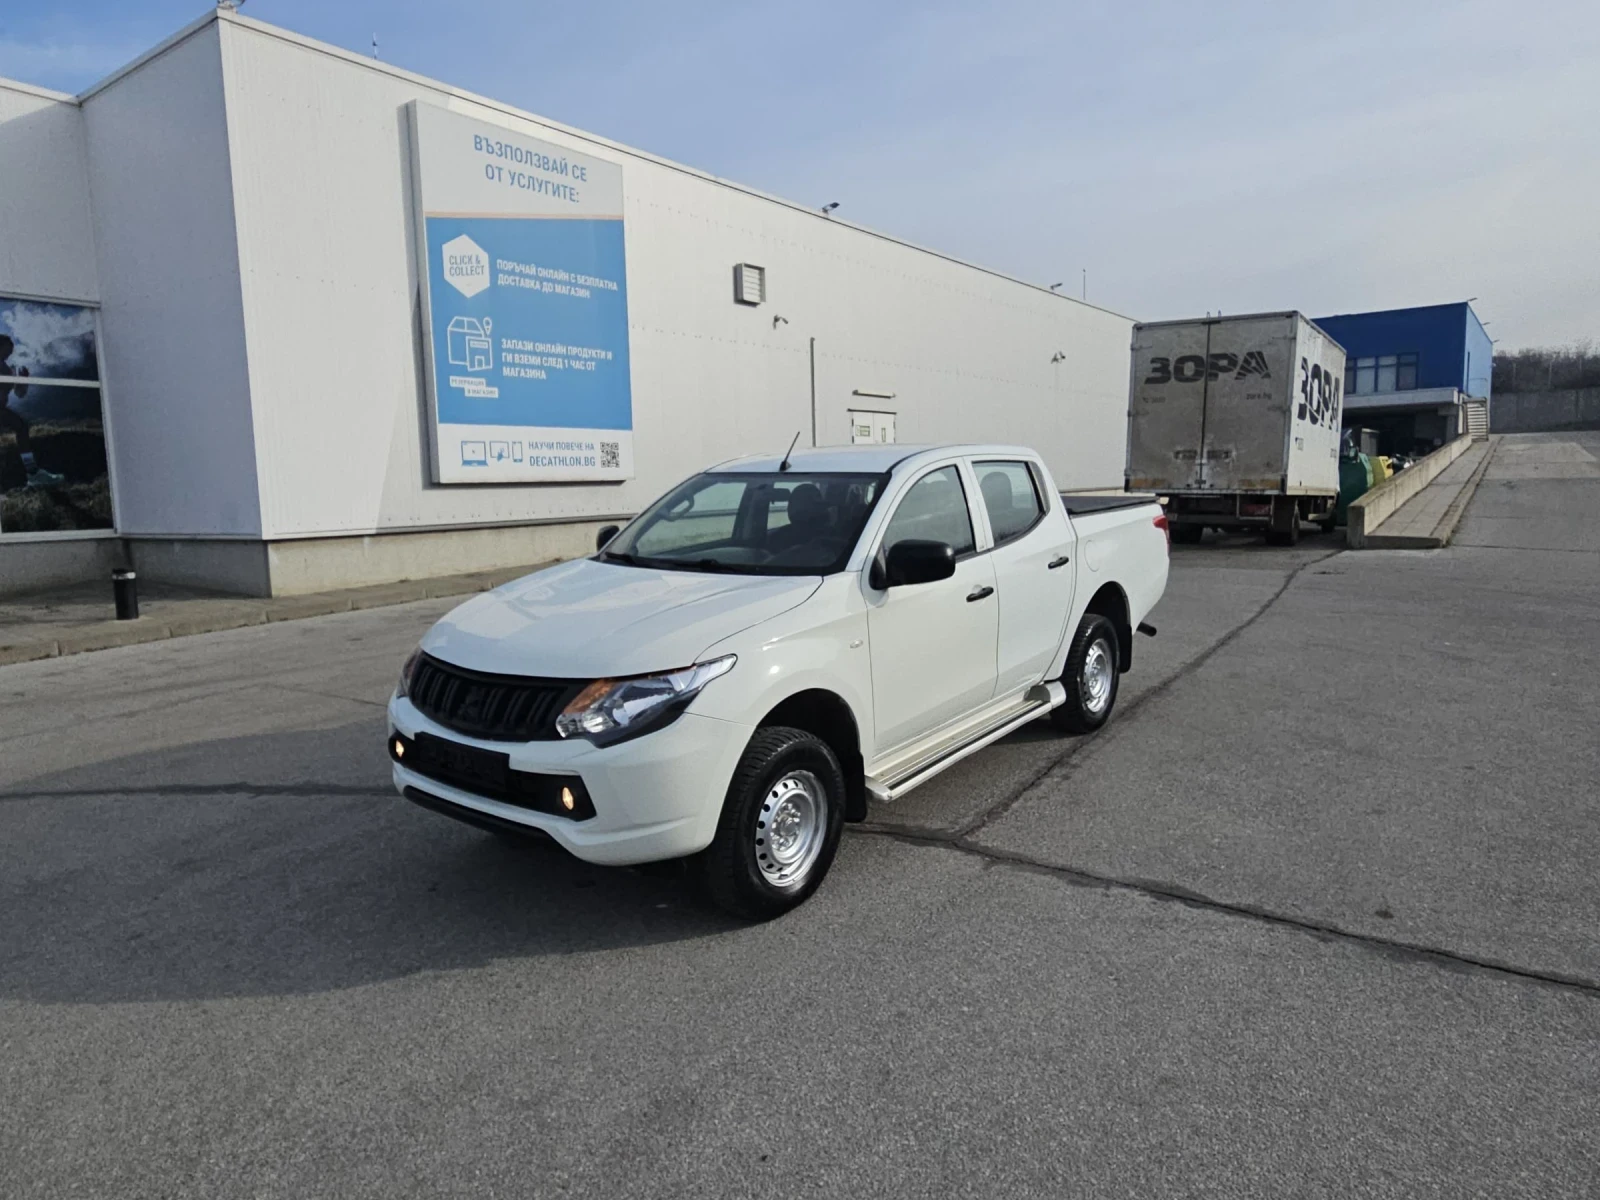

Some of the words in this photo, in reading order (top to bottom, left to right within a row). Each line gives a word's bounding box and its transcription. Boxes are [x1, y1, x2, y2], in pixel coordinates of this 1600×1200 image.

[473, 134, 569, 177] ВЪЗПОЛЗВАЙ
[571, 164, 588, 183] СЕ
[485, 163, 503, 183] ОТ
[508, 169, 580, 203] УСЛУГИТЕ:
[448, 254, 473, 266] CLICK
[475, 254, 481, 265] &
[449, 265, 485, 277] COLLECT
[496, 259, 537, 275] ПОРЪЧАЙ
[537, 266, 569, 282] ОНЛАЙН
[577, 274, 619, 291] БЕЗПЛАТНА
[498, 273, 541, 290] ДОСТАВКА
[541, 281, 554, 293] ДО
[501, 338, 533, 351] ЗАПАЗИ
[535, 341, 567, 356] ОНЛАЙН
[567, 346, 606, 360] ПРОДУКТИ
[606, 351, 613, 361] И
[502, 352, 513, 363] ГИ
[514, 353, 541, 366] ВЗЕМИ
[542, 356, 563, 370] СЛЕД
[569, 360, 586, 371] ЧАС
[586, 361, 596, 371] ОТ
[1144, 351, 1272, 385] ЗОРА
[502, 366, 547, 380] МАГАЗИНА
[528, 440, 555, 451] НАУЧИ
[555, 441, 584, 451] ПОВЕЧЕ
[584, 442, 595, 452] НА
[529, 456, 596, 468] DECATHLON.BG
